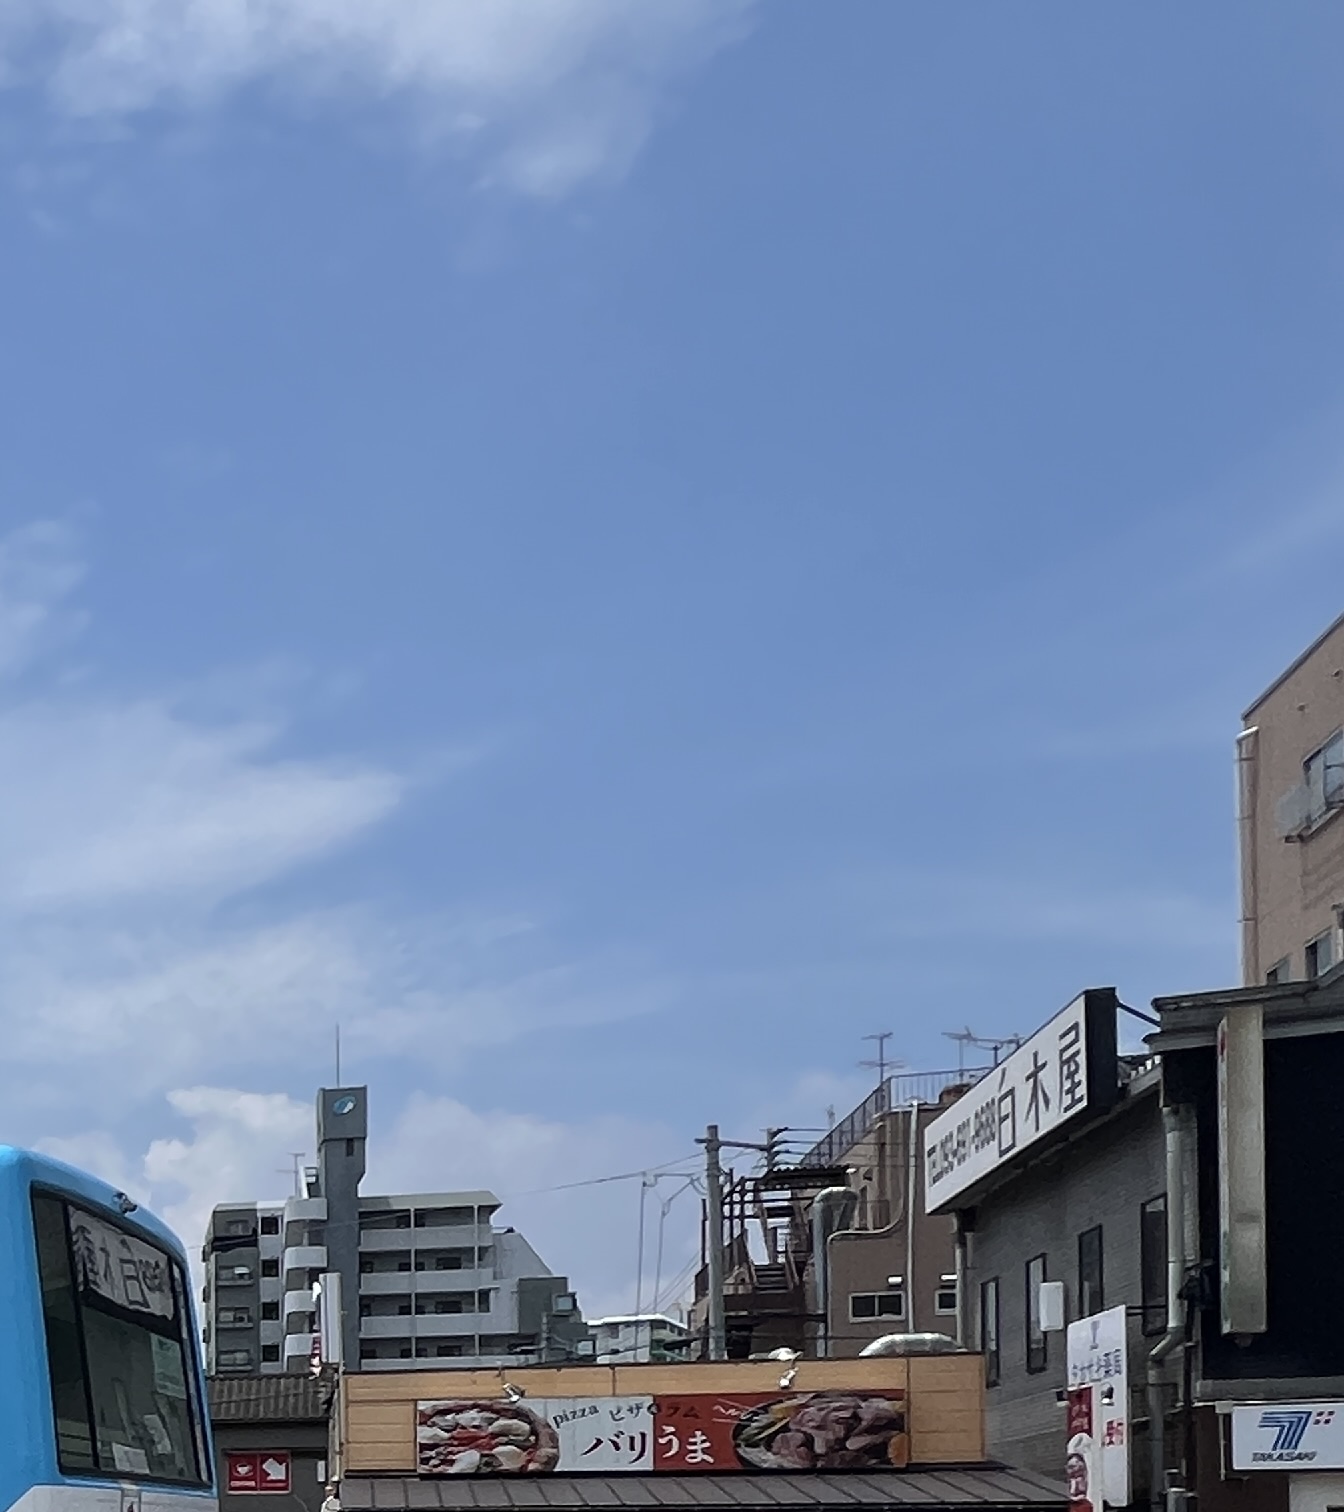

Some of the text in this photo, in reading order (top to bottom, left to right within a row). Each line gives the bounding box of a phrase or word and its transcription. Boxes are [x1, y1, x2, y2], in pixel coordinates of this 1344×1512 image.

[998, 1021, 1085, 1158] 白木屋
[552, 1404, 600, 1427] pizza
[580, 1425, 714, 1464] バリうま
